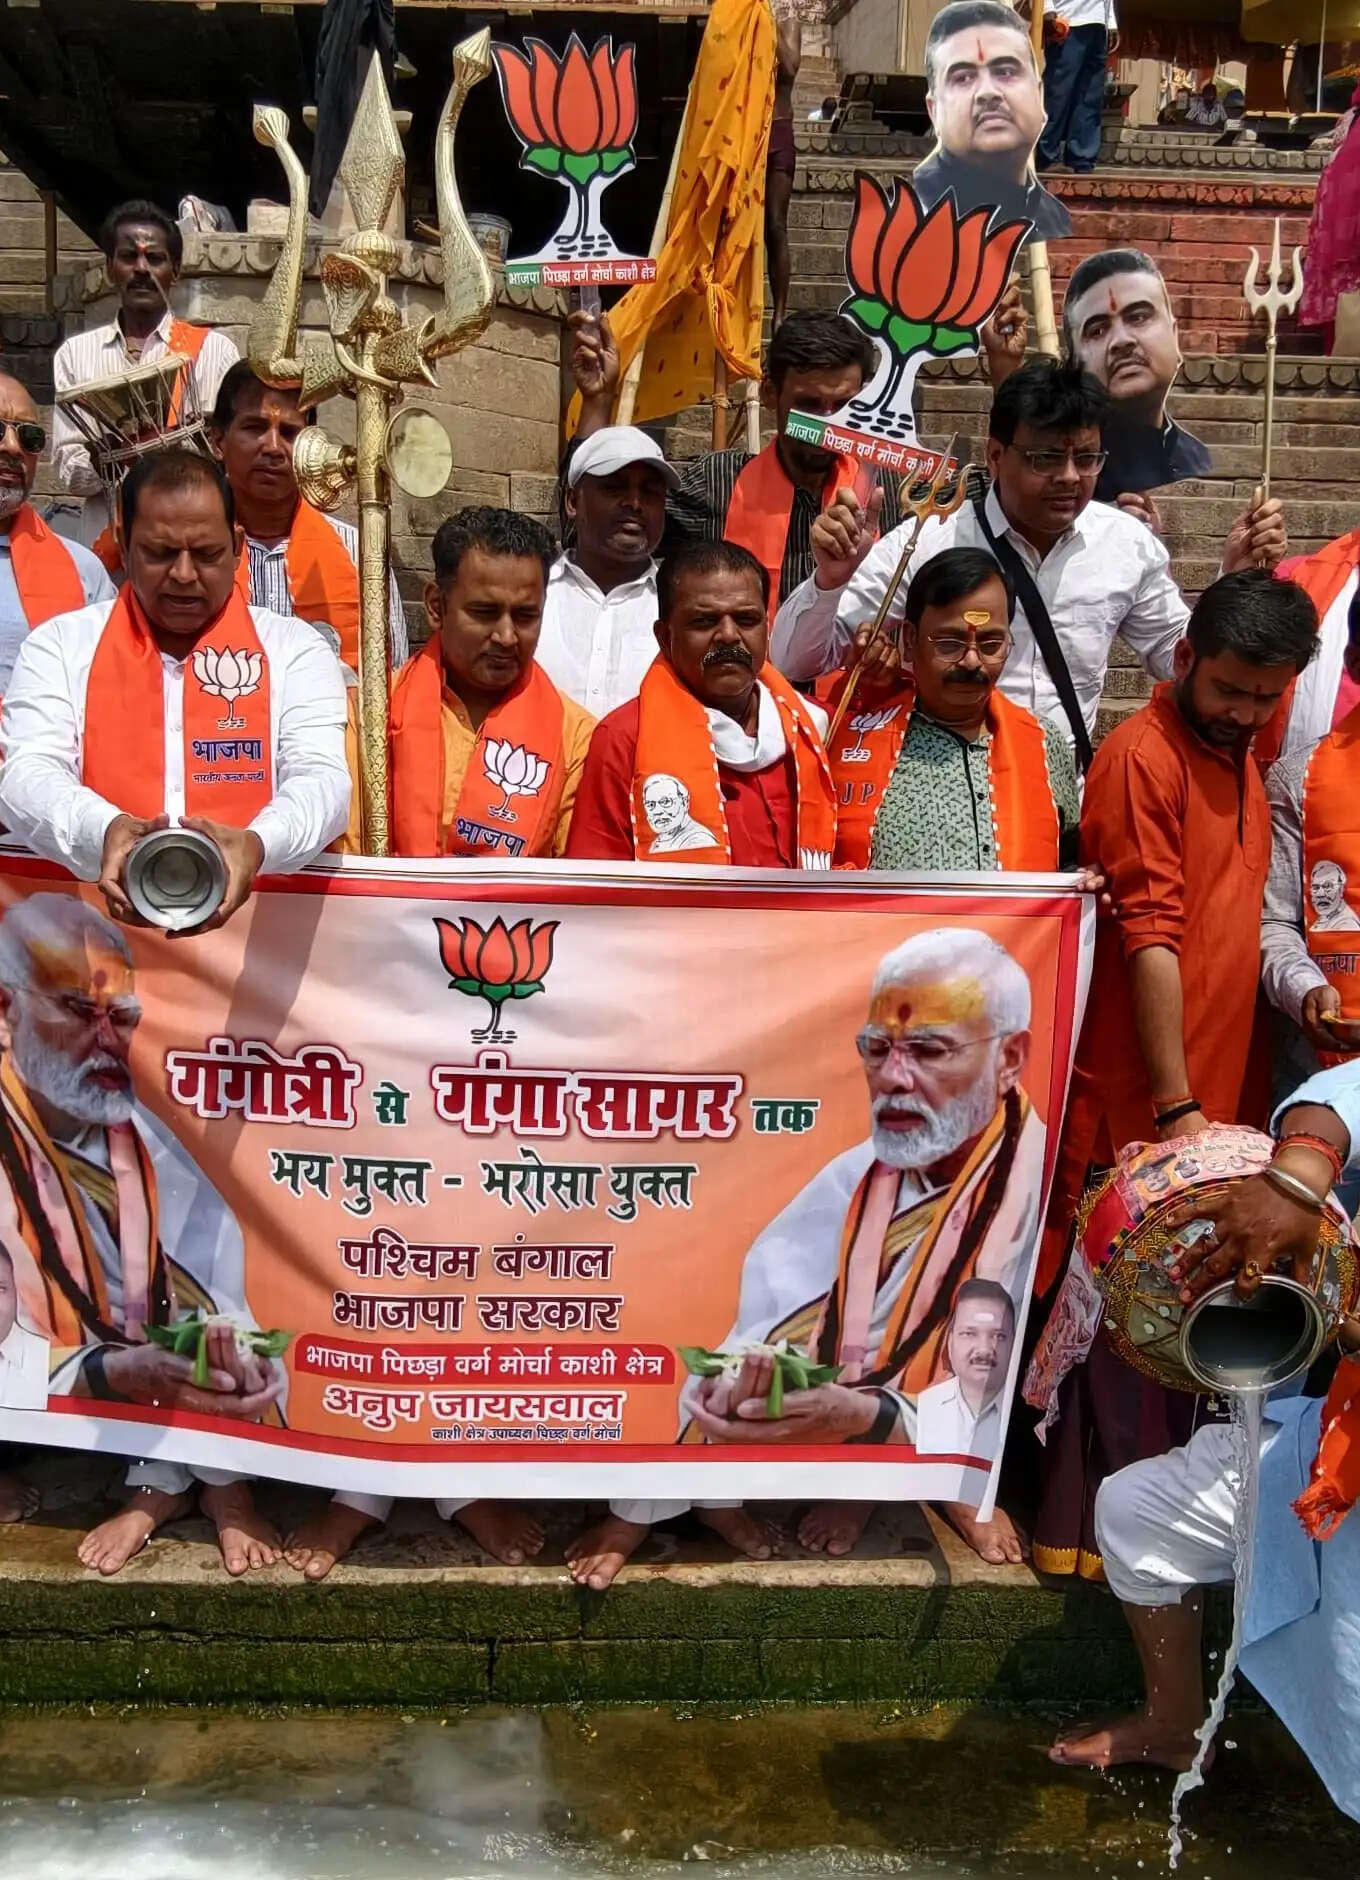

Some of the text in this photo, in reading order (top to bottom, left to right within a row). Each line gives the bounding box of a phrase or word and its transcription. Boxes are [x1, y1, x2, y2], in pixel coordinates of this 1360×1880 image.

[508, 271, 540, 285] भाजपा
[573, 264, 589, 281] वर्ग
[615, 261, 638, 281] काशी
[784, 421, 821, 443] भाजपा
[857, 439, 875, 460] वर्ग
[192, 739, 264, 762] भाजपा
[456, 815, 528, 857] भाजपा
[167, 1038, 820, 1139] गंगोत्री से गंगा सागर तक
[269, 1148, 334, 1199] भय
[341, 1154, 433, 1216] मुक्त
[479, 1147, 604, 1215] भरोसा
[607, 1162, 700, 1222] युक्त
[338, 1225, 615, 1280] पश्चिम बंगाल
[333, 1291, 624, 1332] भाजपा सरकार
[306, 1345, 665, 1382] भाजपा पिछड़ा वर्ग मोर्चा काशी क्षेत्र
[323, 1383, 628, 1432] अनुप जायसवाल
[431, 1423, 462, 1440] काशी
[465, 1423, 486, 1440] क्षेत्र
[571, 1422, 591, 1440] वर्ग
